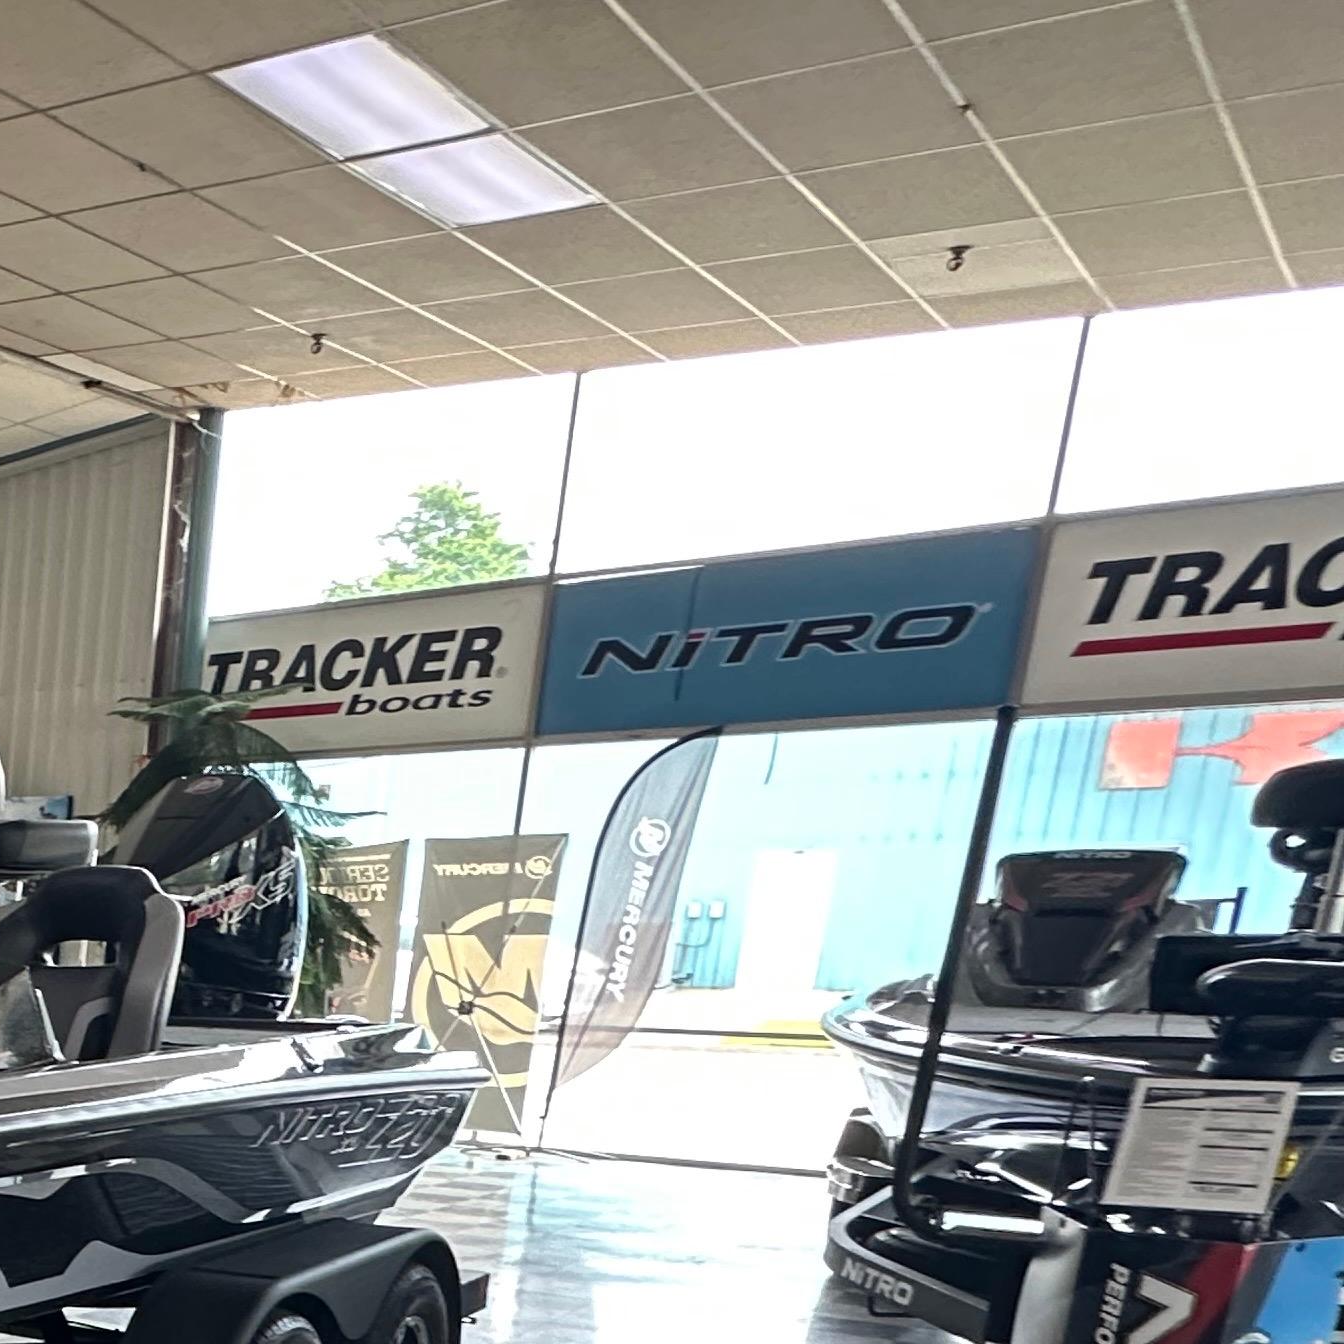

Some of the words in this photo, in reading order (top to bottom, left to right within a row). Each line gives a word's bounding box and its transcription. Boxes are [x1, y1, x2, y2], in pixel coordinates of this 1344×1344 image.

[208, 626, 503, 697] TRACKER
[345, 689, 493, 716] boats
[606, 861, 654, 1003] MERCURY
